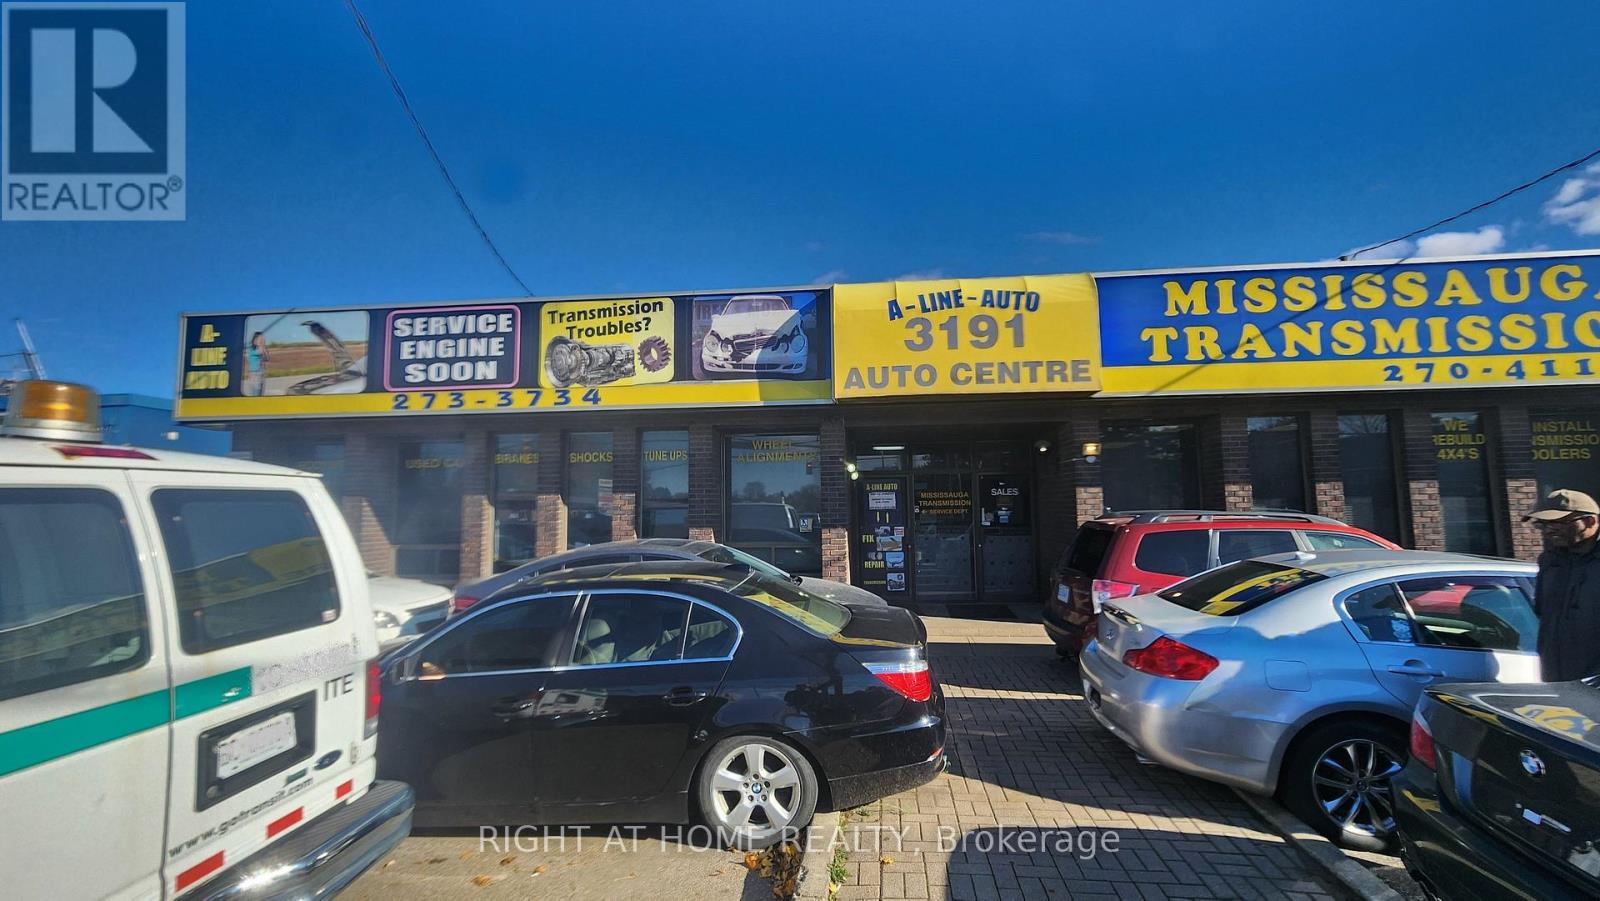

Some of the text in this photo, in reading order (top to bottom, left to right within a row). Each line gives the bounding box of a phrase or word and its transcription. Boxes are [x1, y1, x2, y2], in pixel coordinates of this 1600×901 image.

[1163, 264, 1600, 316] MISSISSAUG
[547, 299, 664, 325] Transmission
[394, 312, 513, 337] SERVICE
[566, 317, 652, 339] Troubles?
[904, 313, 1026, 351] 3191
[399, 337, 505, 360] ENGINE
[404, 360, 498, 383] SOON
[843, 359, 1093, 390] AUTO CENTRE
[393, 388, 602, 409] 273-3734
[1443, 420, 1469, 432] WE
[1532, 421, 1597, 432] INSTALL
[569, 451, 614, 464] SHOCKS
[644, 450, 688, 462] TUNE UPS
[990, 487, 1020, 496] SALES
